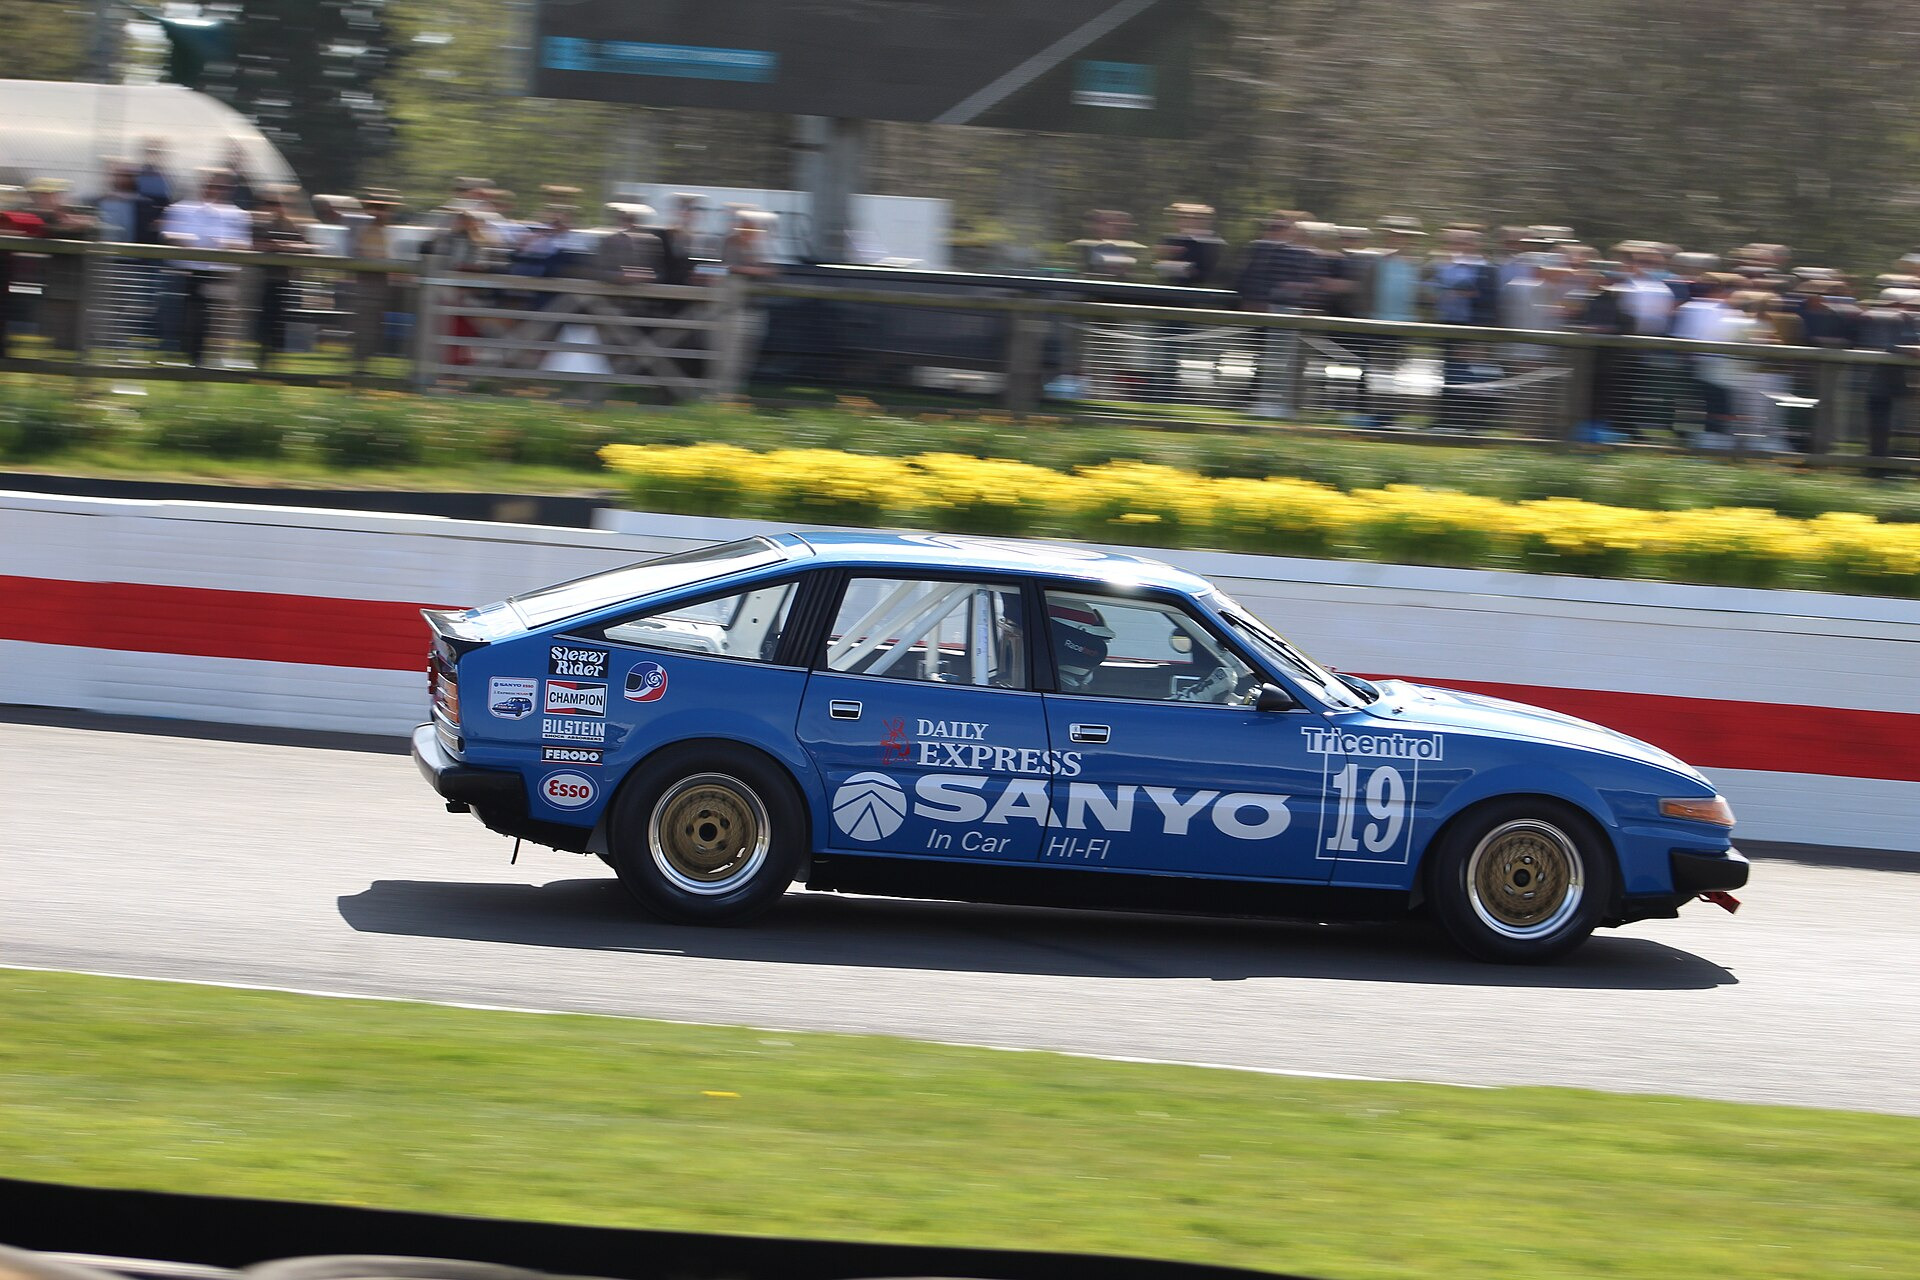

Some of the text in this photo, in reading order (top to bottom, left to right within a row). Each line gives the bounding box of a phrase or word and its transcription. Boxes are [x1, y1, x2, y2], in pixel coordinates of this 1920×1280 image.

[551, 646, 608, 665] Sleazy
[555, 660, 604, 677] Rider
[549, 691, 603, 706] CHAMPION
[542, 718, 606, 737] BILSTEIN
[916, 718, 990, 741] DAILY
[1301, 726, 1444, 761] Tricentrol
[545, 749, 600, 762] FERODO
[916, 741, 1083, 777] EXPRESS
[913, 773, 1292, 840] SANYO
[1325, 763, 1406, 853] 19
[926, 828, 1111, 860] In Car HI-FI
